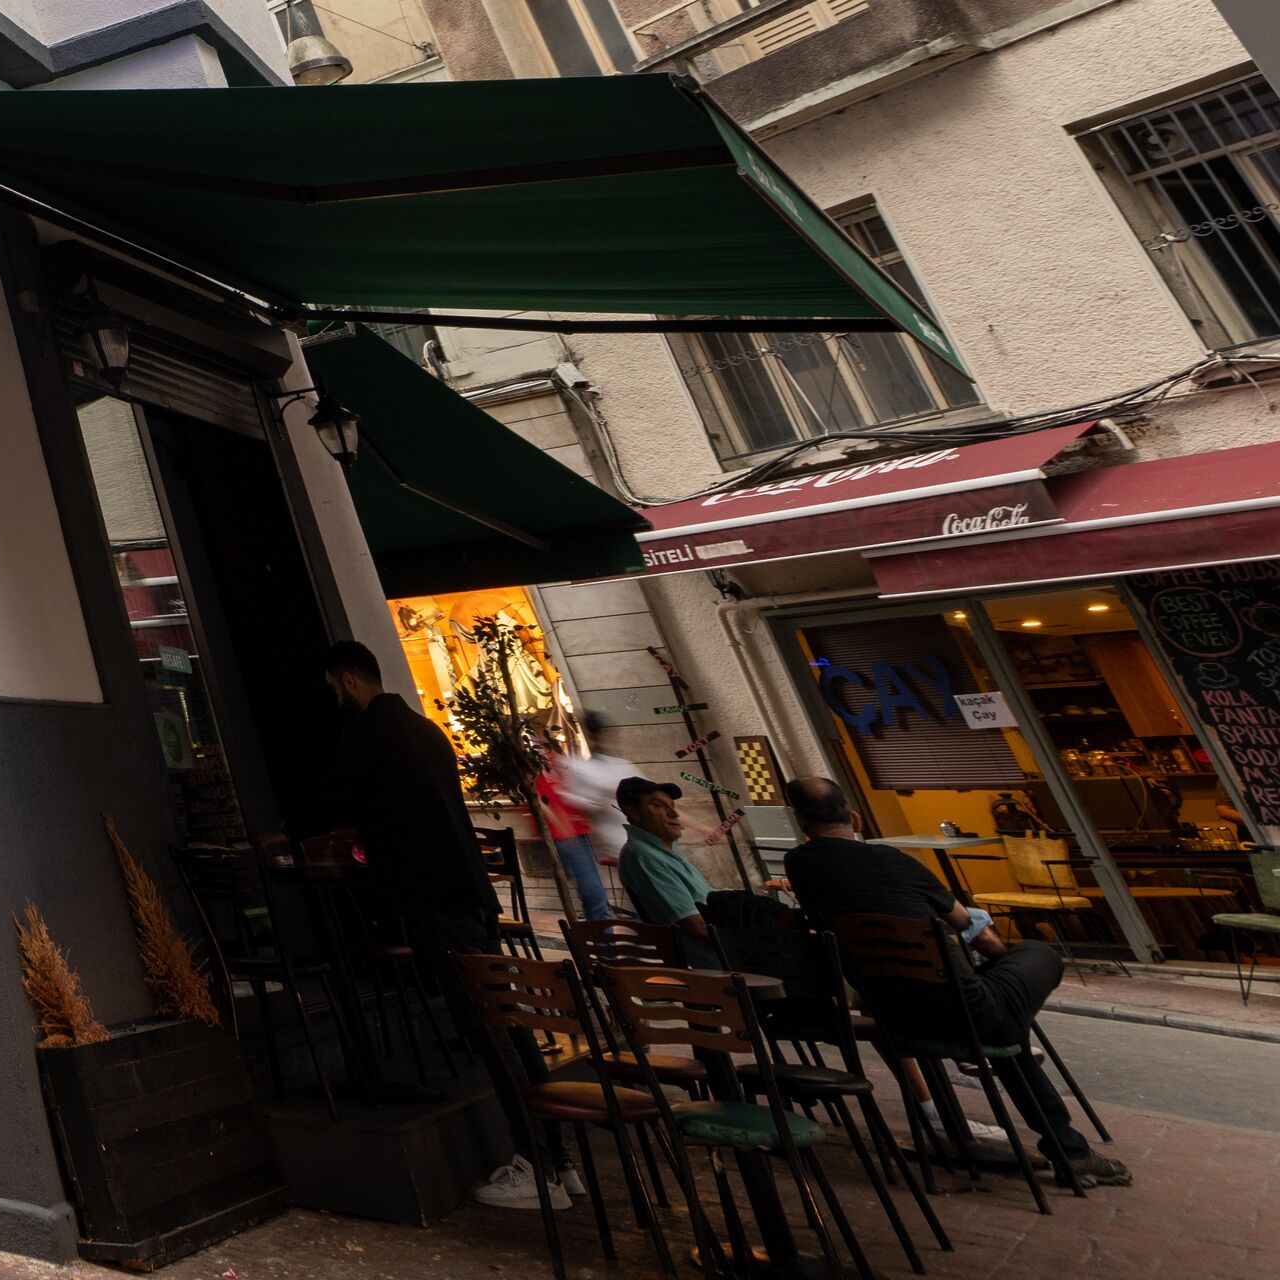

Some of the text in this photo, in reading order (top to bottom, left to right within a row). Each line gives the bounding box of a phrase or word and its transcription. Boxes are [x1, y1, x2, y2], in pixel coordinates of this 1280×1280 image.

[942, 502, 1029, 537] Coca-Cola
[1160, 592, 1211, 613] BEST
[1158, 612, 1224, 632] COFFEE
[1181, 630, 1236, 648] EVER
[819, 655, 957, 736] ÇAY
[957, 694, 997, 708] kaçak
[1201, 689, 1259, 707] KOLA
[971, 710, 997, 721] Çay
[1209, 705, 1280, 726] FANTA
